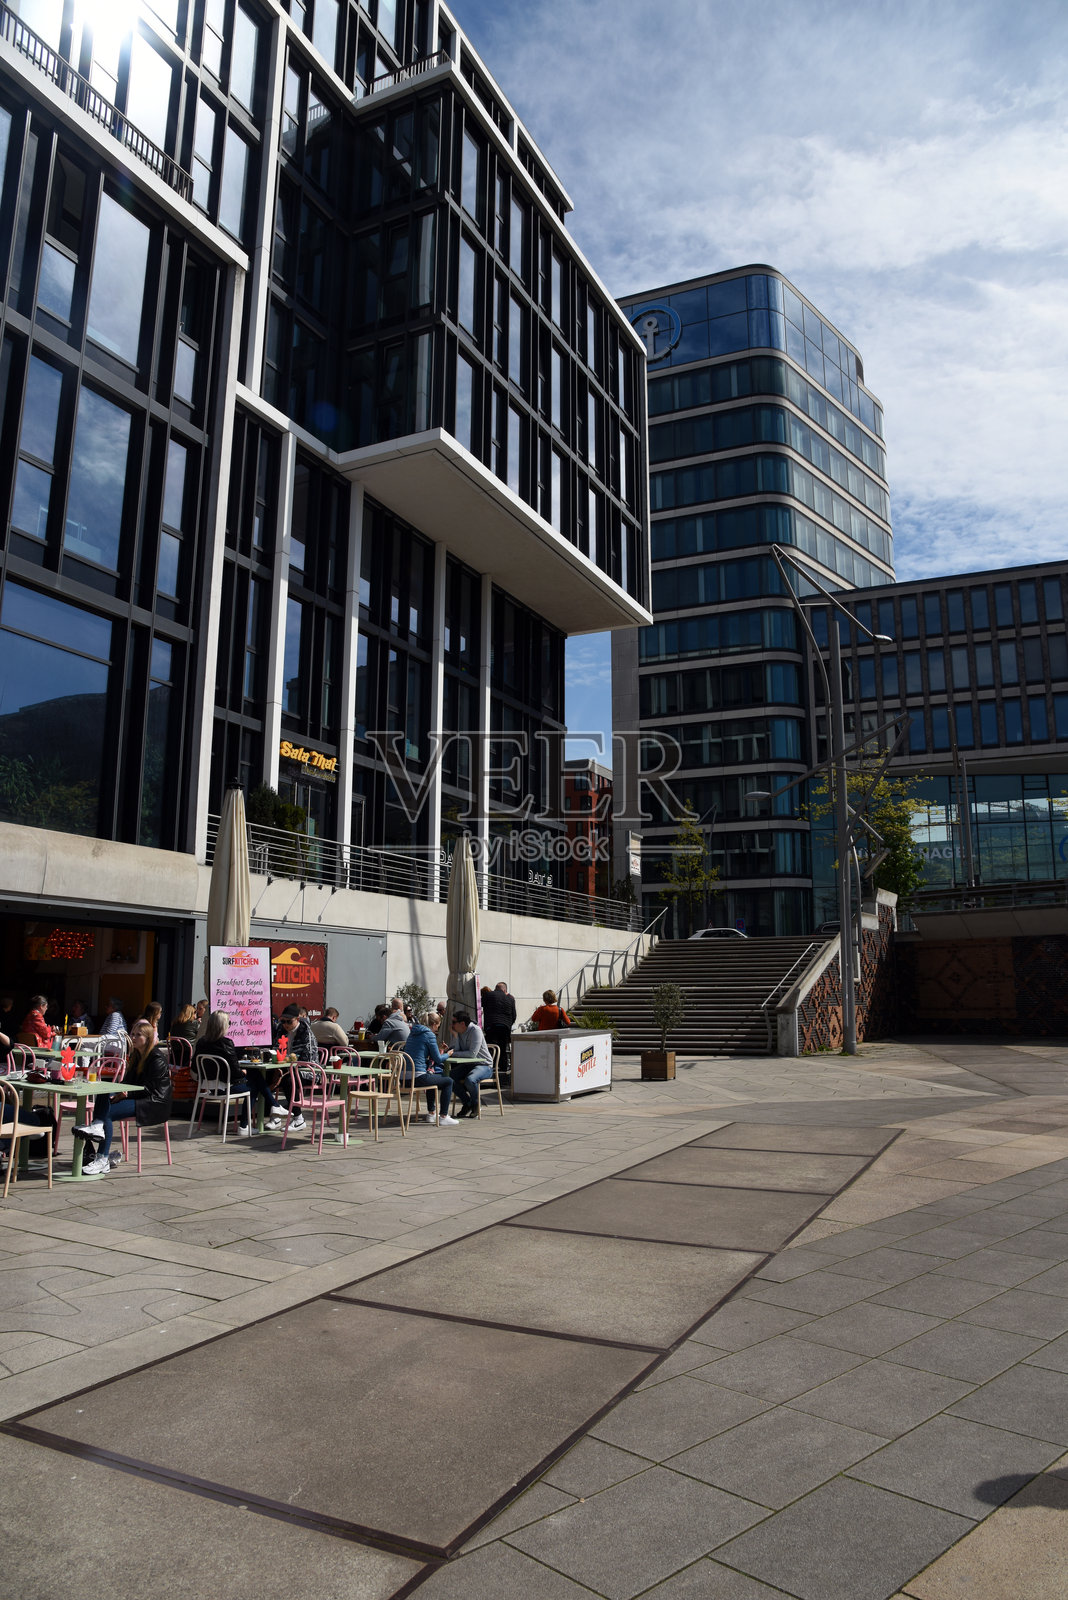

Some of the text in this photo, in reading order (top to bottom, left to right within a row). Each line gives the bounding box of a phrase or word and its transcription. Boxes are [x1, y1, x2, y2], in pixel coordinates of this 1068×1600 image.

[280, 741, 337, 770] Sala Thai
[222, 957, 259, 966] SURFKITCHEN
[271, 965, 320, 984] FKITCHEN
[216, 978, 263, 989] Breakfast, Bagels
[216, 989, 232, 997] Pizza
[216, 999, 227, 1009] Egg
[247, 998, 264, 1007] Bowls
[246, 1009, 263, 1018] Coffee
[240, 1019, 264, 1028] Cocktails
[227, 1029, 267, 1038] etfood, Dessert
[577, 1056, 597, 1078] Spritz
